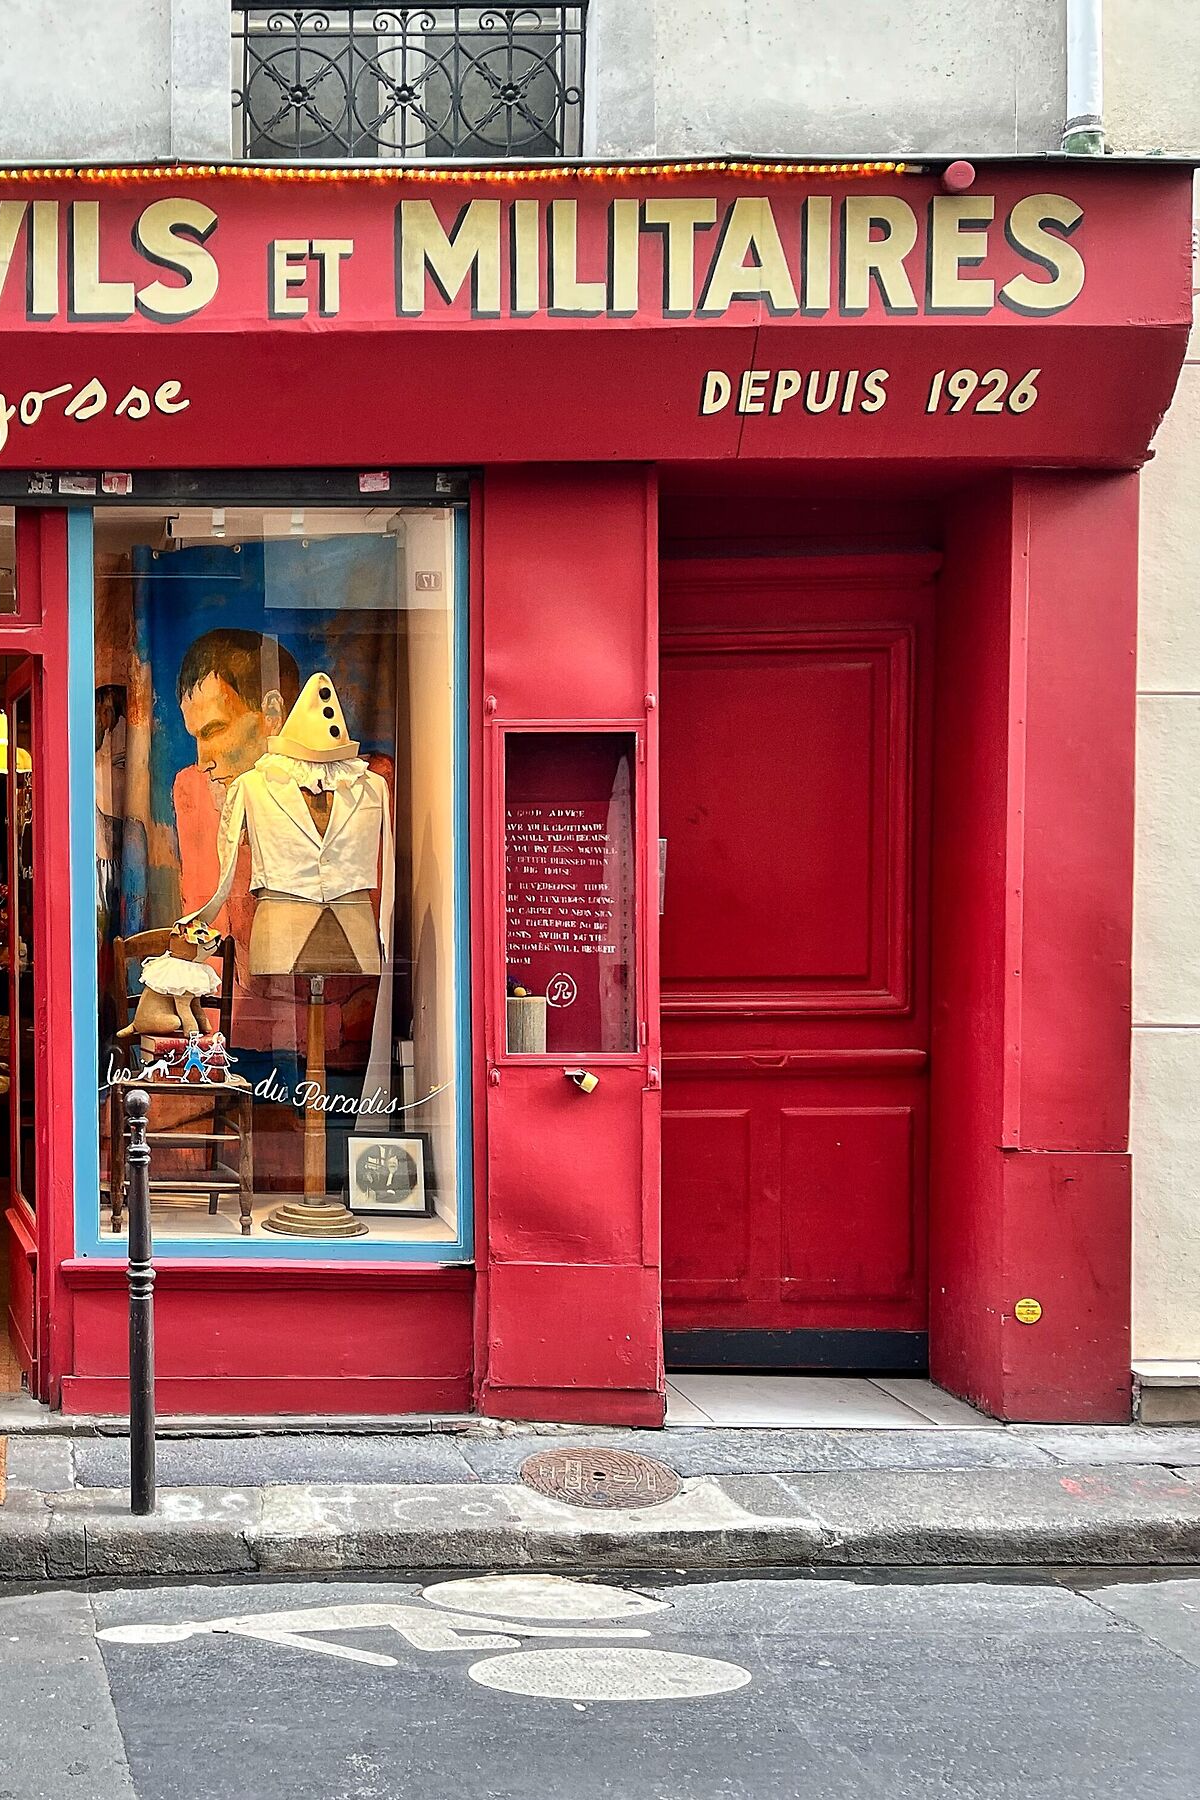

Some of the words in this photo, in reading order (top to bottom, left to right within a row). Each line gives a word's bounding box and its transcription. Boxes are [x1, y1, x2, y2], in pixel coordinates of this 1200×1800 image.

[270, 239, 353, 315] ET
[398, 194, 1085, 315] MILITAIRES
[702, 369, 888, 415] DEPUIS
[928, 369, 1042, 414] 1926
[549, 810, 585, 818] ADVICE
[534, 846, 549, 854] PAY
[523, 866, 538, 874] BIG
[518, 907, 553, 915] CARPET
[525, 918, 577, 928] THEREFORE
[254, 1068, 289, 1103] du
[292, 1081, 398, 1115] Paradis
